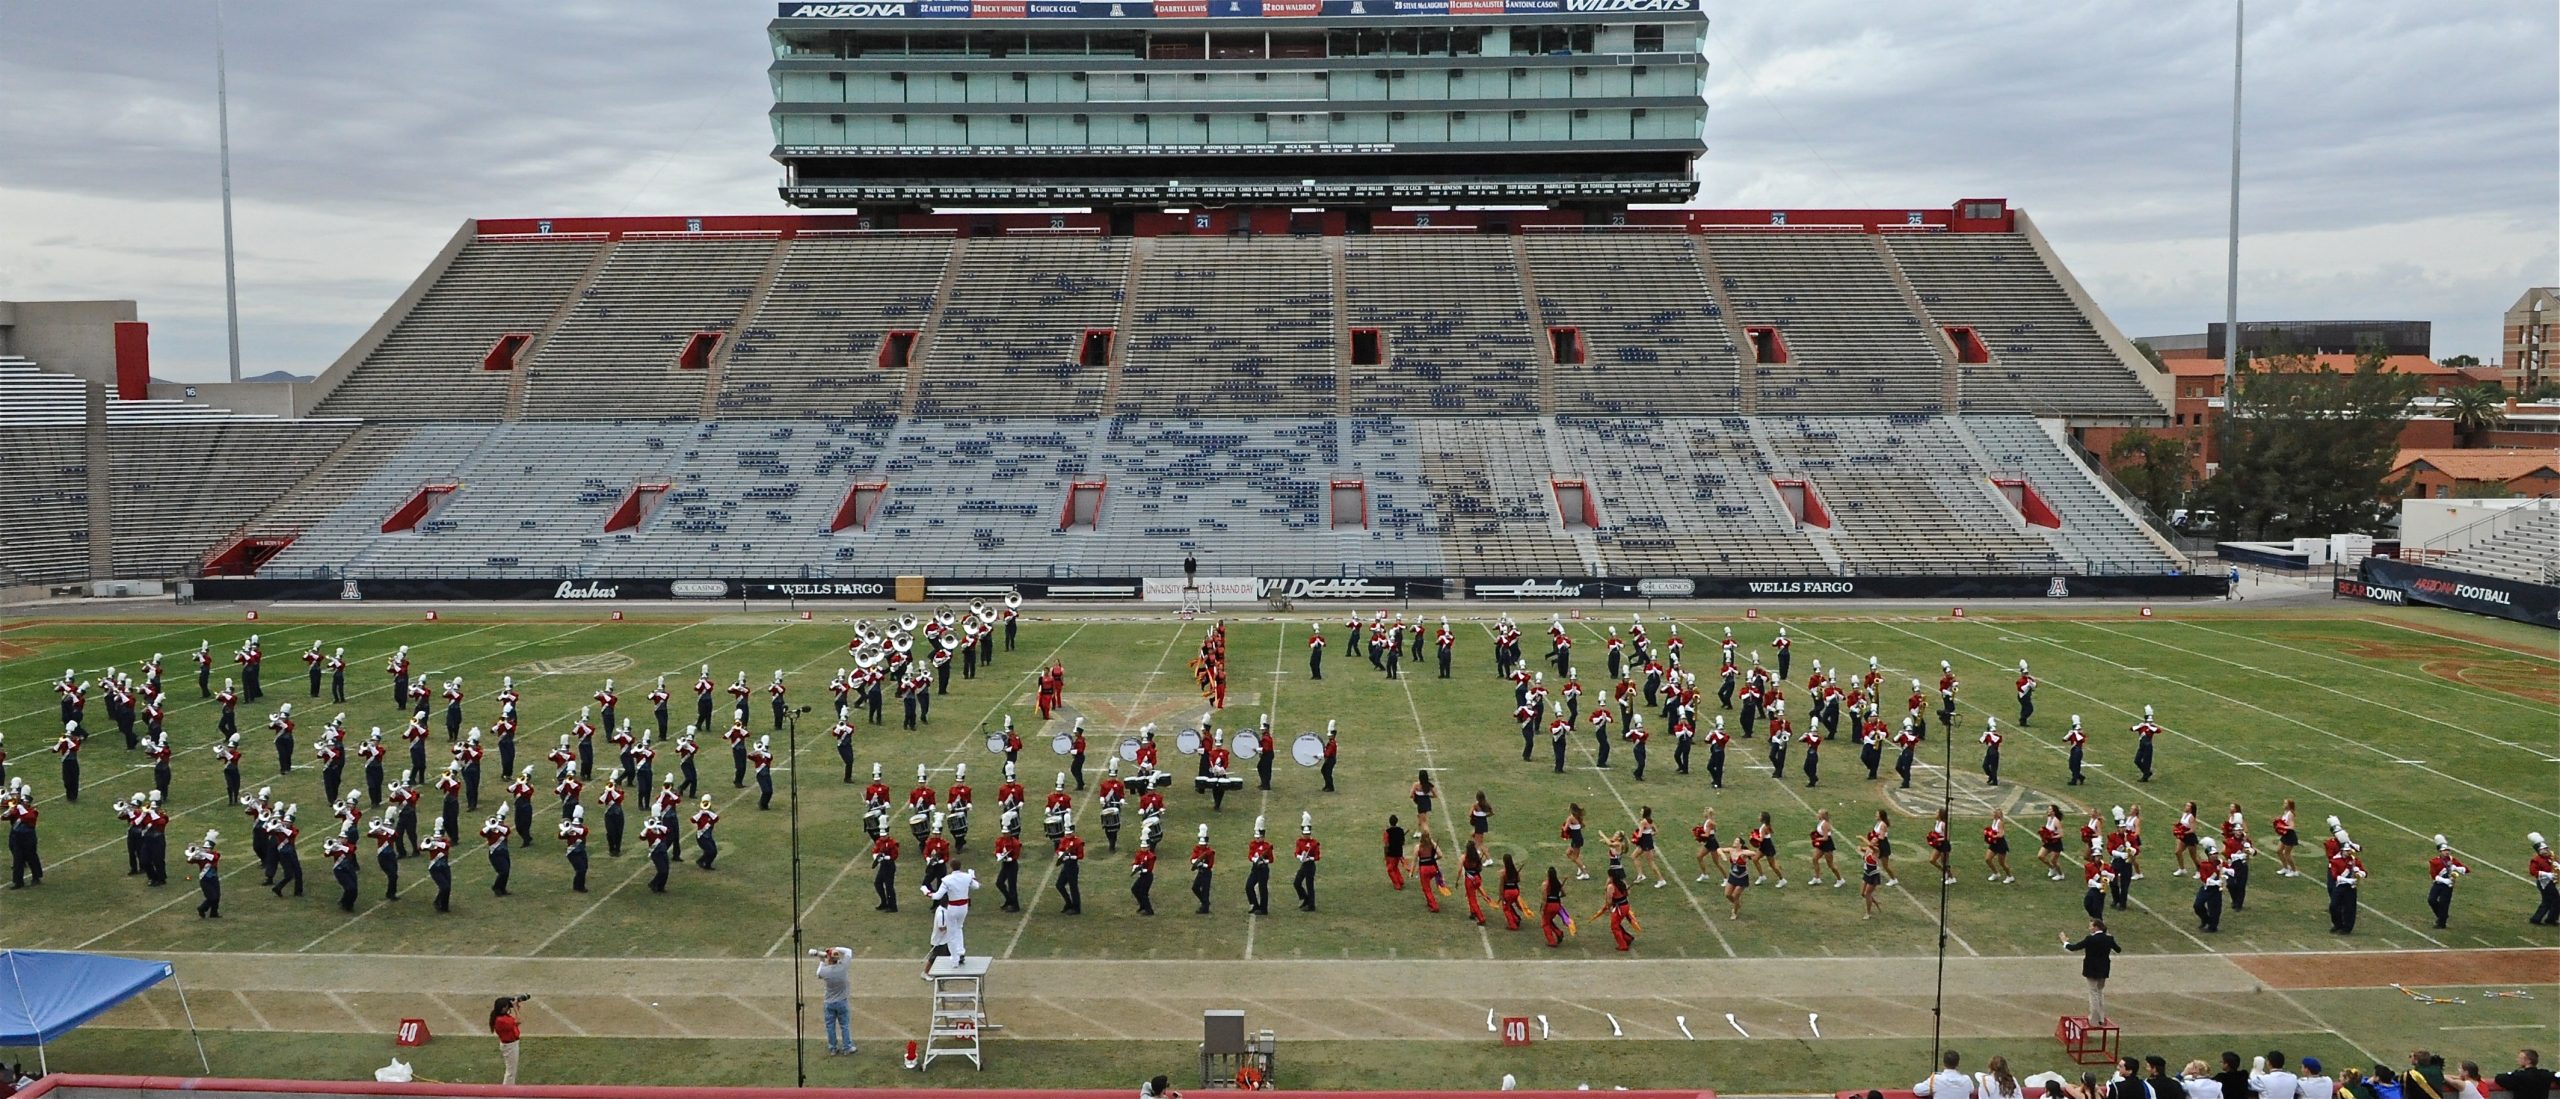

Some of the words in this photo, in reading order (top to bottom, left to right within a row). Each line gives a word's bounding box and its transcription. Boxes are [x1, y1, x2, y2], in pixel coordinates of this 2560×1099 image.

[1566, 0, 1691, 11] WILDCATS
[791, 4, 906, 17] ARIZONA
[1051, 220, 1064, 229] 20
[1197, 219, 1208, 228] 21
[1417, 217, 1430, 226] 22
[1612, 217, 1625, 225] 23
[1772, 216, 1785, 225] 24
[1909, 216, 1922, 225] 25
[540, 225, 550, 234] 17
[689, 223, 700, 232] 18
[859, 222, 870, 230] 19
[186, 387, 196, 397] 16
[554, 580, 619, 599] Bashas'
[677, 584, 691, 592] SOL
[692, 584, 722, 592] CASINOS
[780, 584, 832, 594] WELLS
[834, 584, 883, 594] FARGO
[1146, 585, 1180, 594] UNIVERSITY
[1221, 585, 1240, 594] BAND
[1241, 585, 1254, 594] DAY
[1656, 583, 1689, 591] CASINOS
[1749, 582, 1801, 593] WELLS
[1803, 582, 1853, 593] FARGO
[400, 1022, 418, 1042] 40
[957, 1022, 971, 1039] 50
[1506, 1021, 1526, 1042] 40
